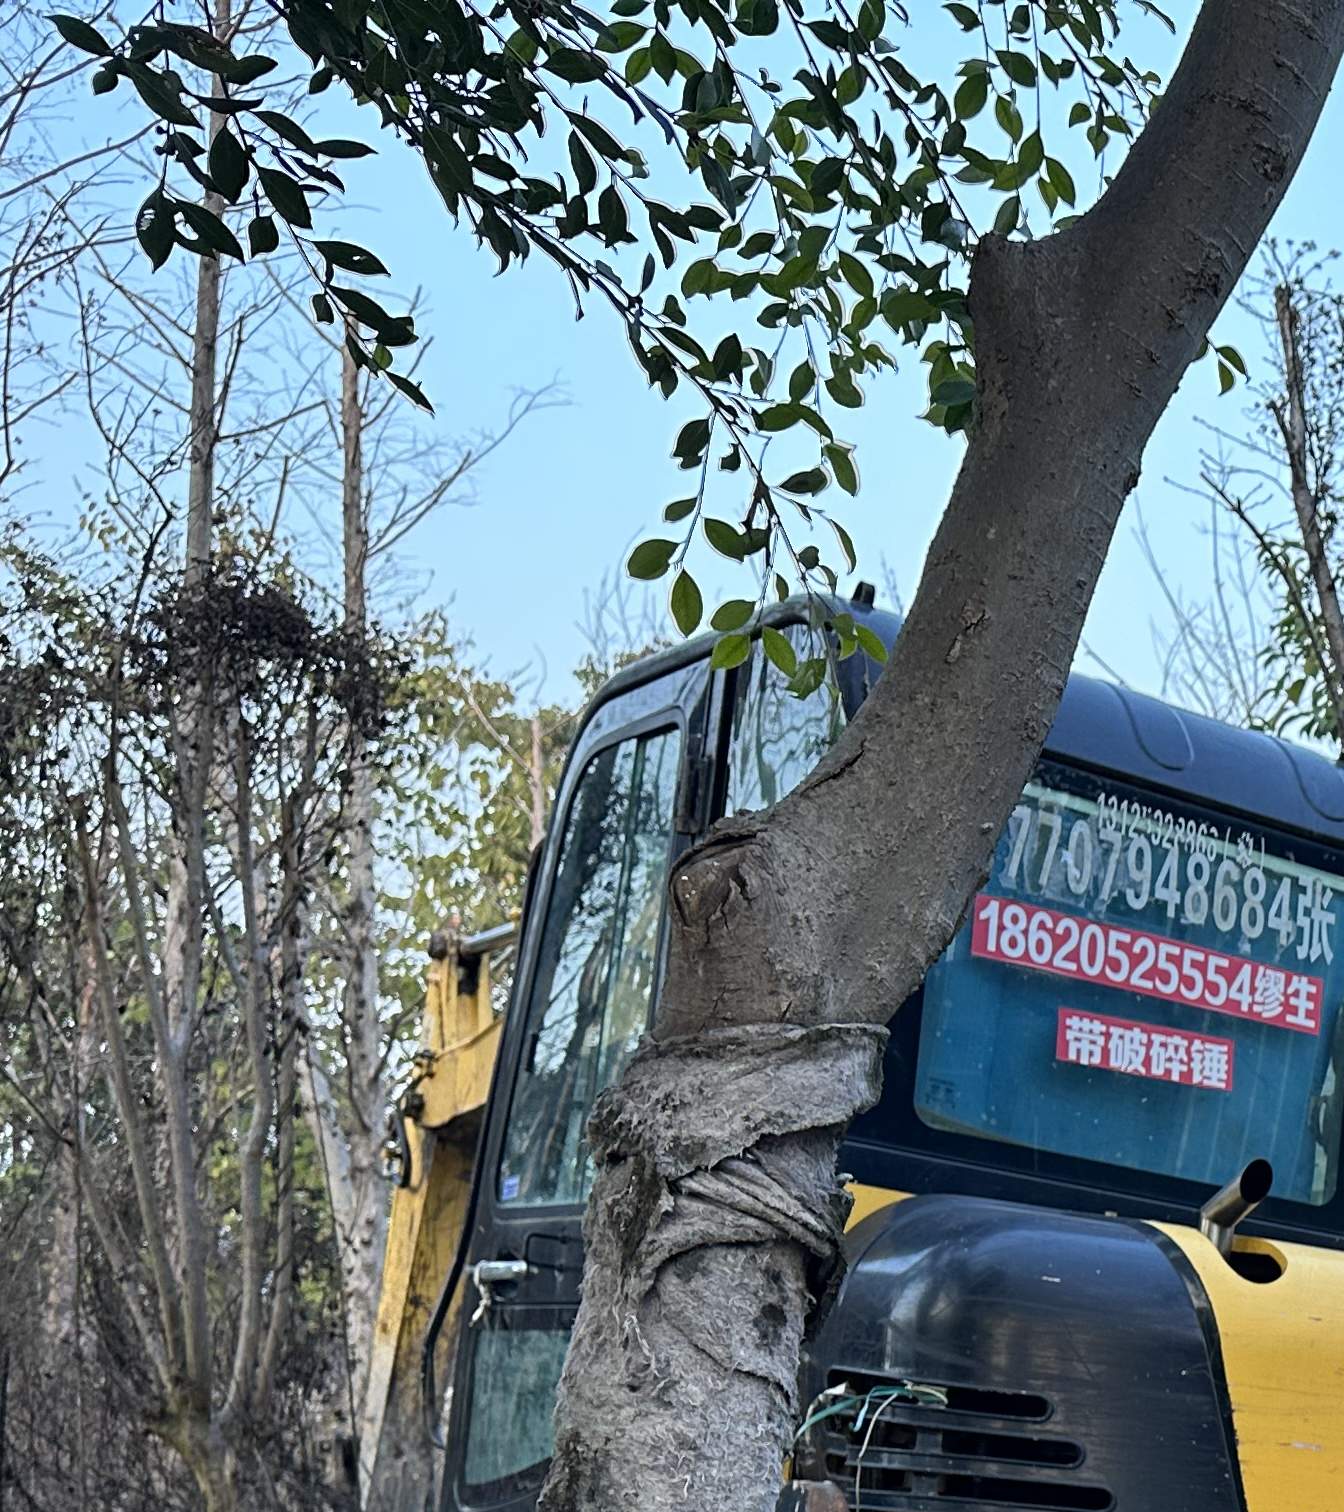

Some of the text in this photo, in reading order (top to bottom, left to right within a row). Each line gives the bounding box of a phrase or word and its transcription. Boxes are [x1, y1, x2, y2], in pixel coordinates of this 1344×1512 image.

[978, 899, 1319, 1029] 18620525554缪生
[1065, 1016, 1230, 1089] 带破碎锤
